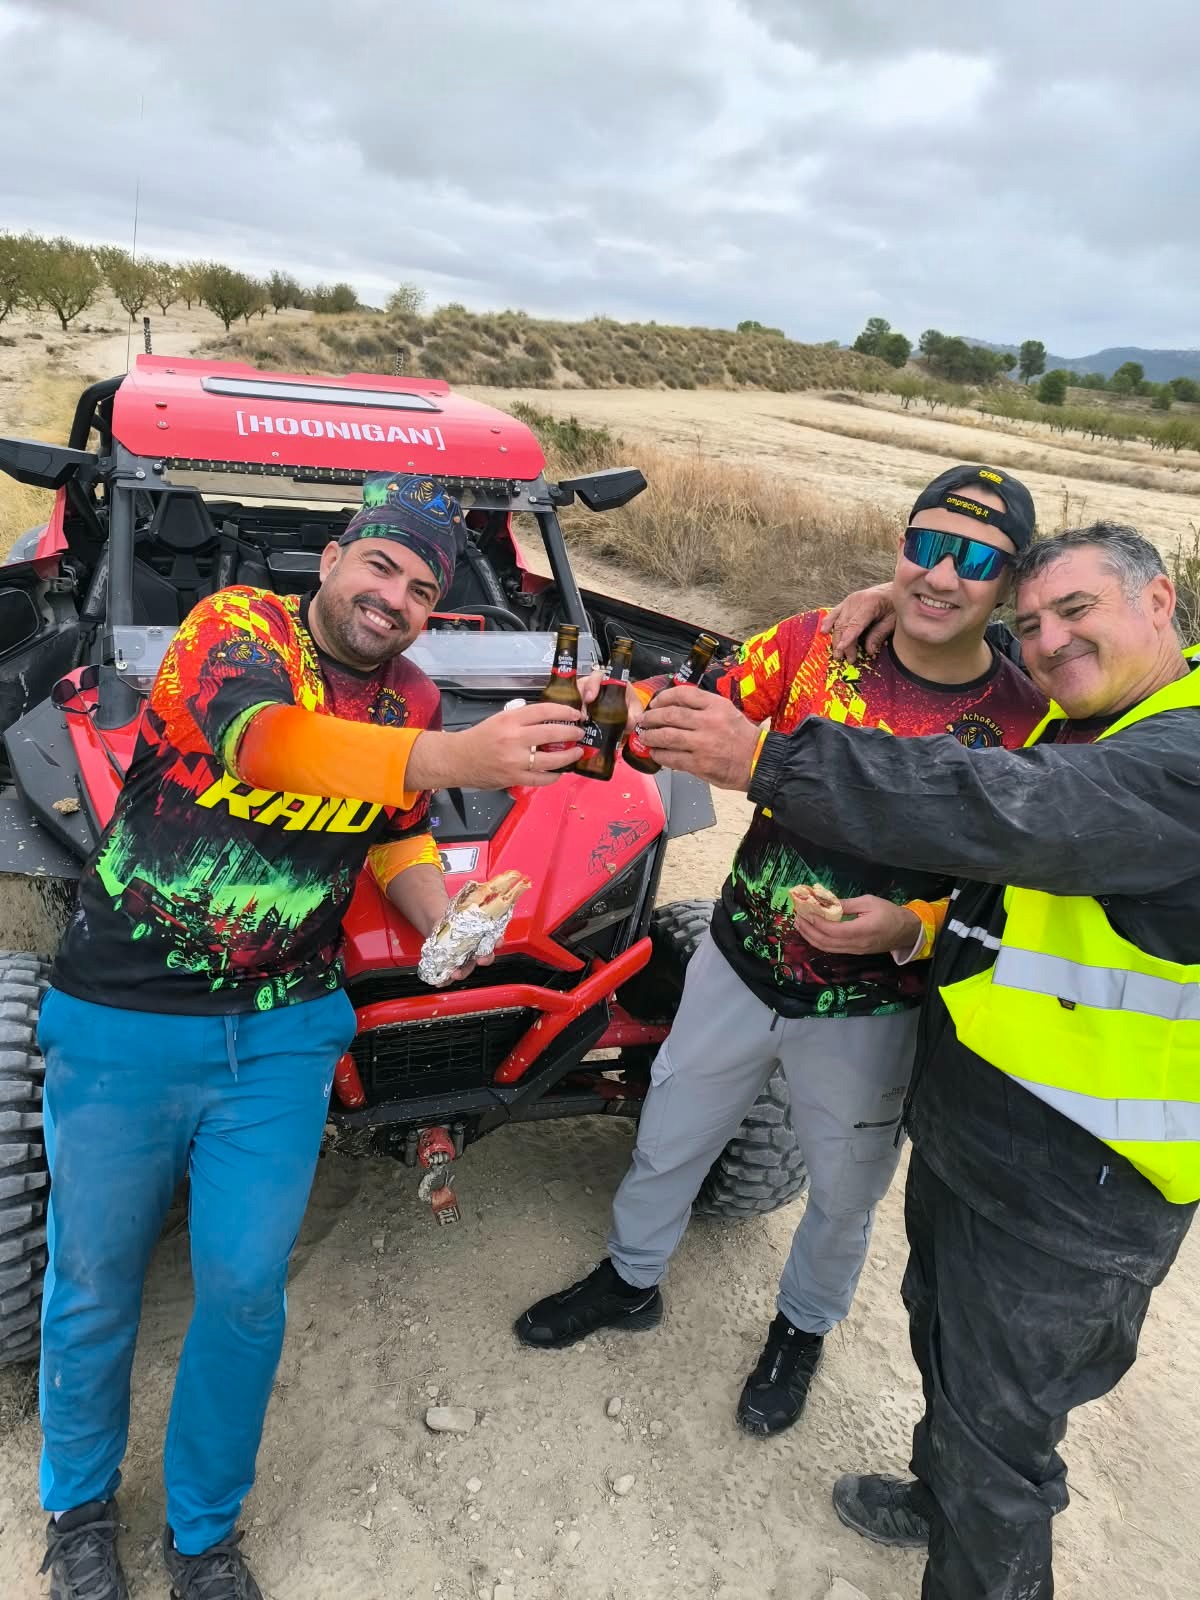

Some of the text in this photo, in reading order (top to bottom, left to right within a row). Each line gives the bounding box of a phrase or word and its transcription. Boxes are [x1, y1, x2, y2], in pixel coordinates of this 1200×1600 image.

[946, 497, 989, 517] ompracing.it
[962, 712, 1004, 736] AchoRaid
[194, 769, 384, 834] RAID
